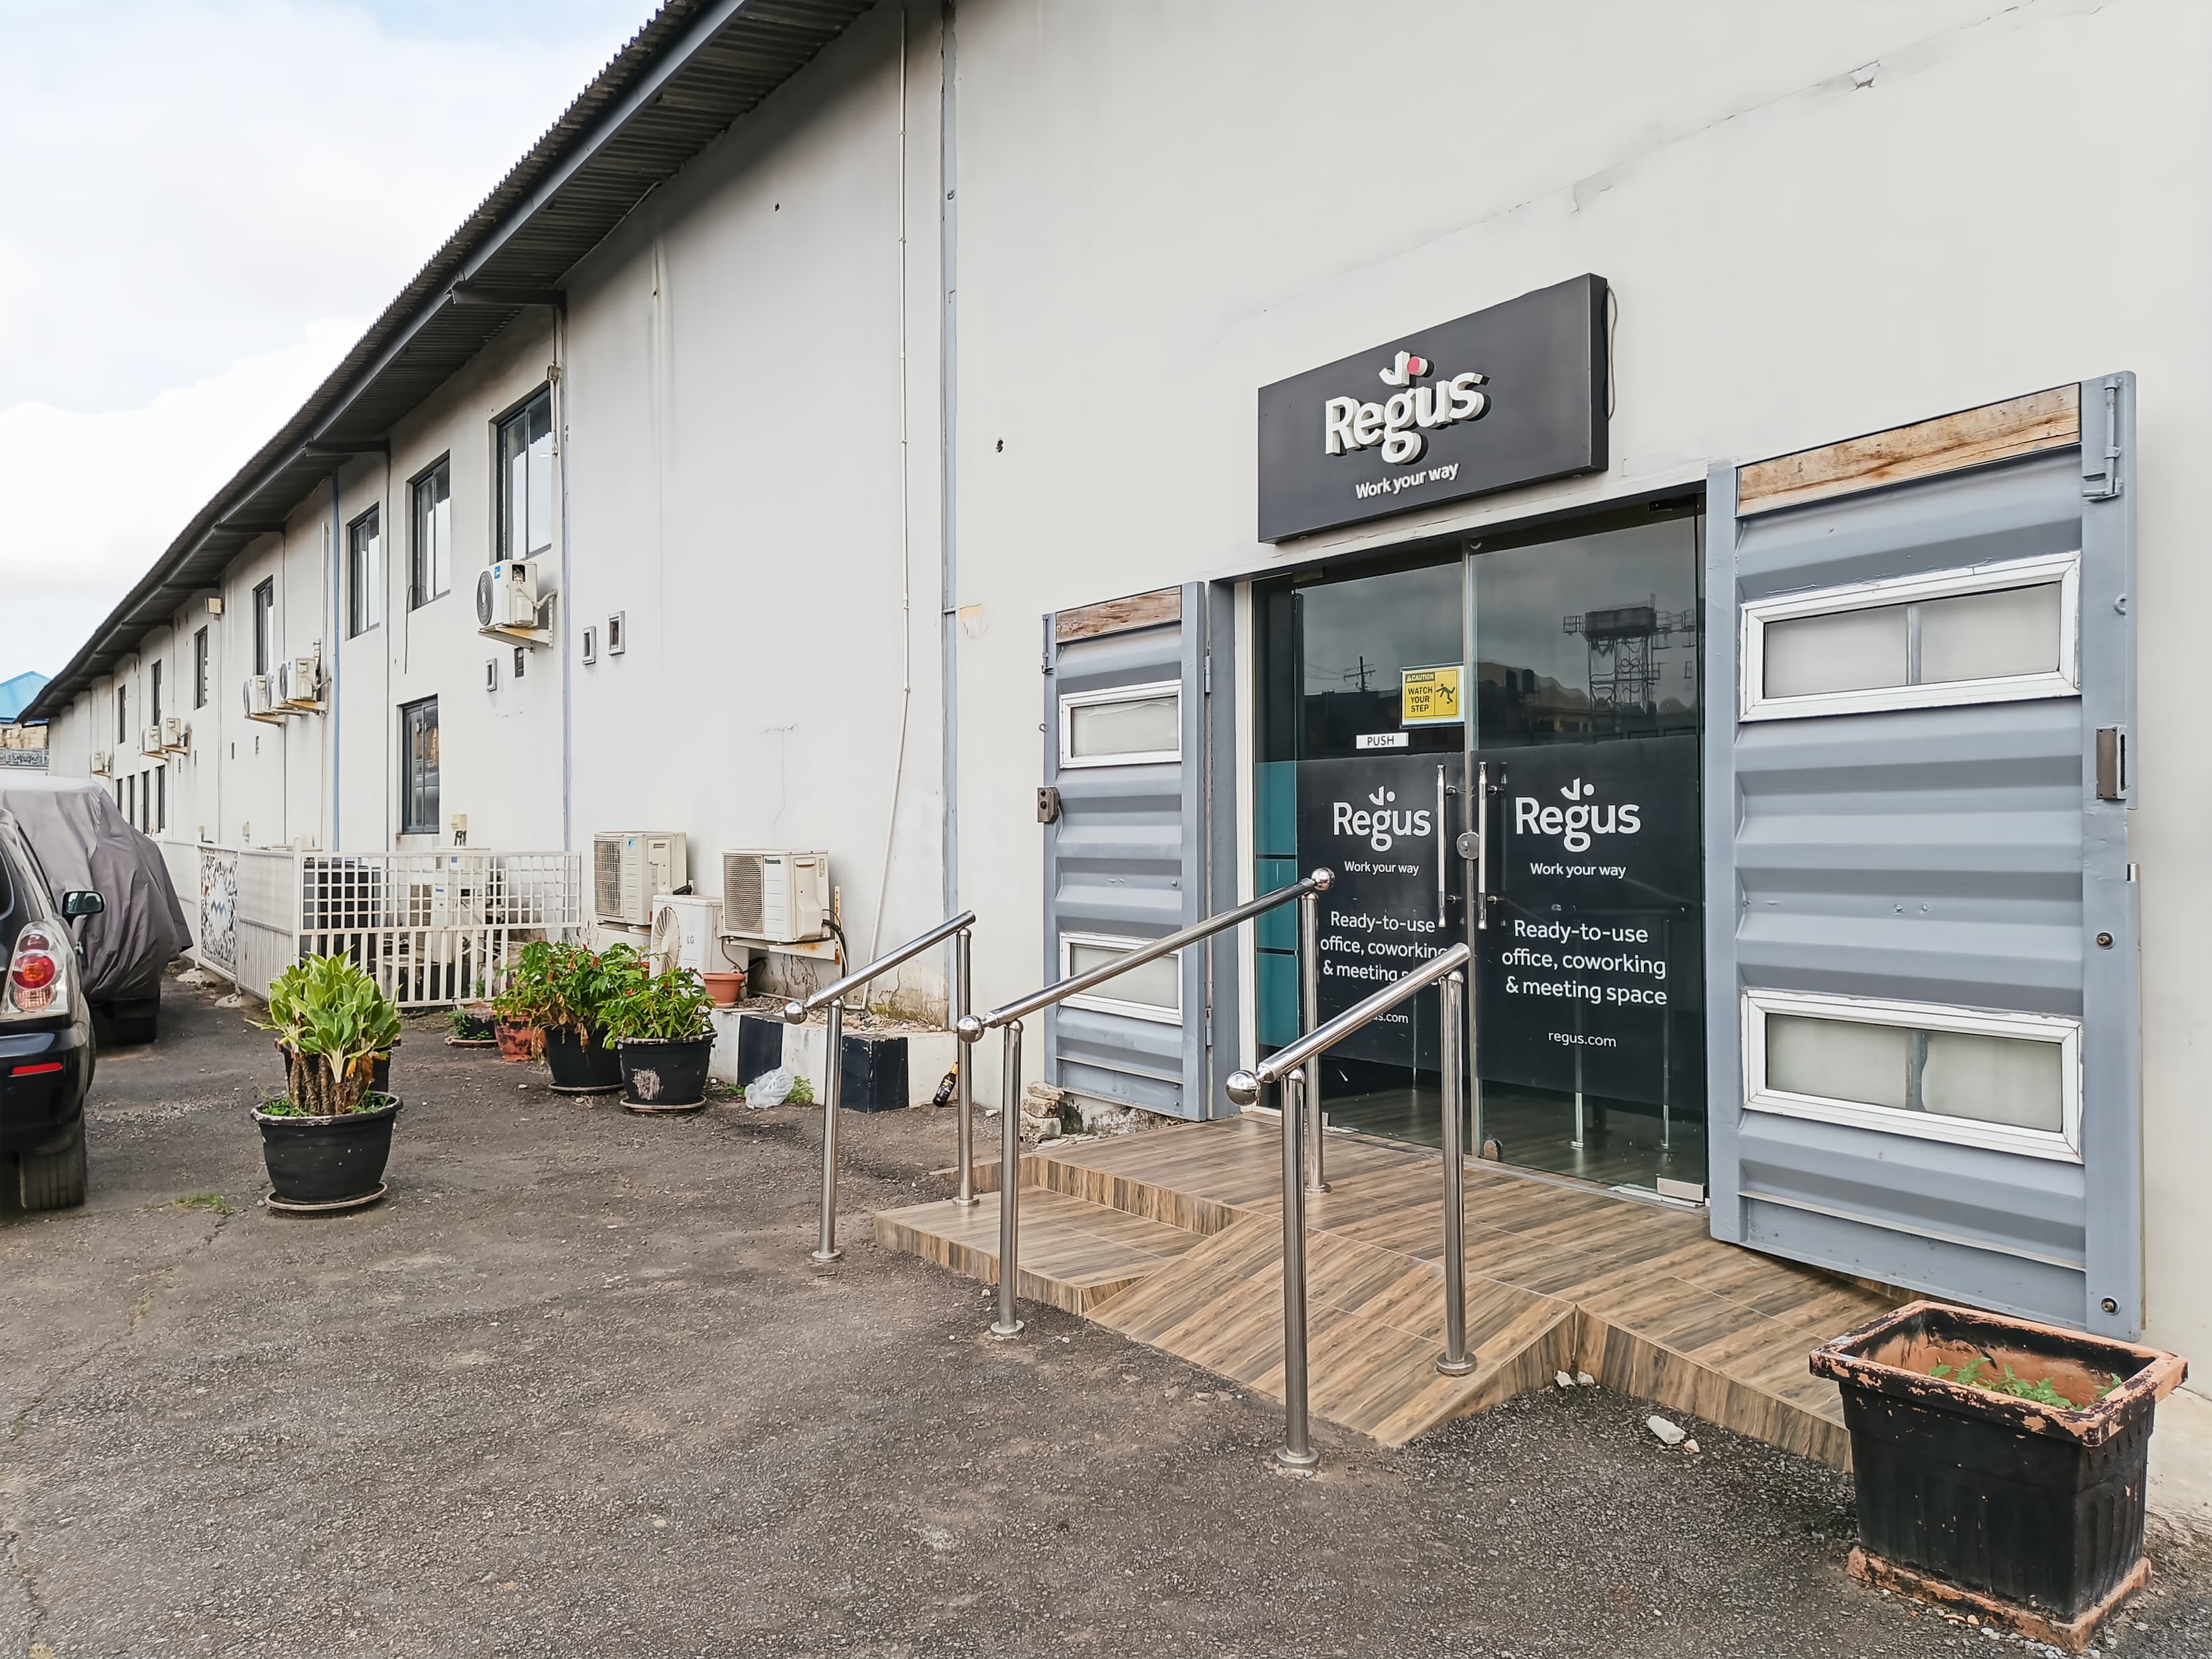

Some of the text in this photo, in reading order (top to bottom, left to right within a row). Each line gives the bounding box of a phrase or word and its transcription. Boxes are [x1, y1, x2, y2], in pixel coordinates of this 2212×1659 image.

[1325, 372, 1485, 464] Regus
[1355, 463, 1460, 499] Work your way
[1412, 673, 1434, 681] CAUTION
[1408, 686, 1433, 694] WATCH
[1367, 735, 1395, 746] PUSH
[1333, 802, 1432, 852] Regus
[1515, 796, 1641, 852] Regus
[1344, 861, 1420, 877] Work your way
[1530, 863, 1627, 879] Work your way
[1330, 911, 1436, 933] Ready-to-use
[1514, 919, 1649, 944] Ready-to-use
[687, 935, 694, 944] LG
[1320, 936, 1364, 955] office,
[1323, 959, 1334, 976] &
[1501, 948, 1666, 980] office, coworking
[1506, 976, 1668, 1006] & meeting space
[1548, 1031, 1616, 1047] regus.com
